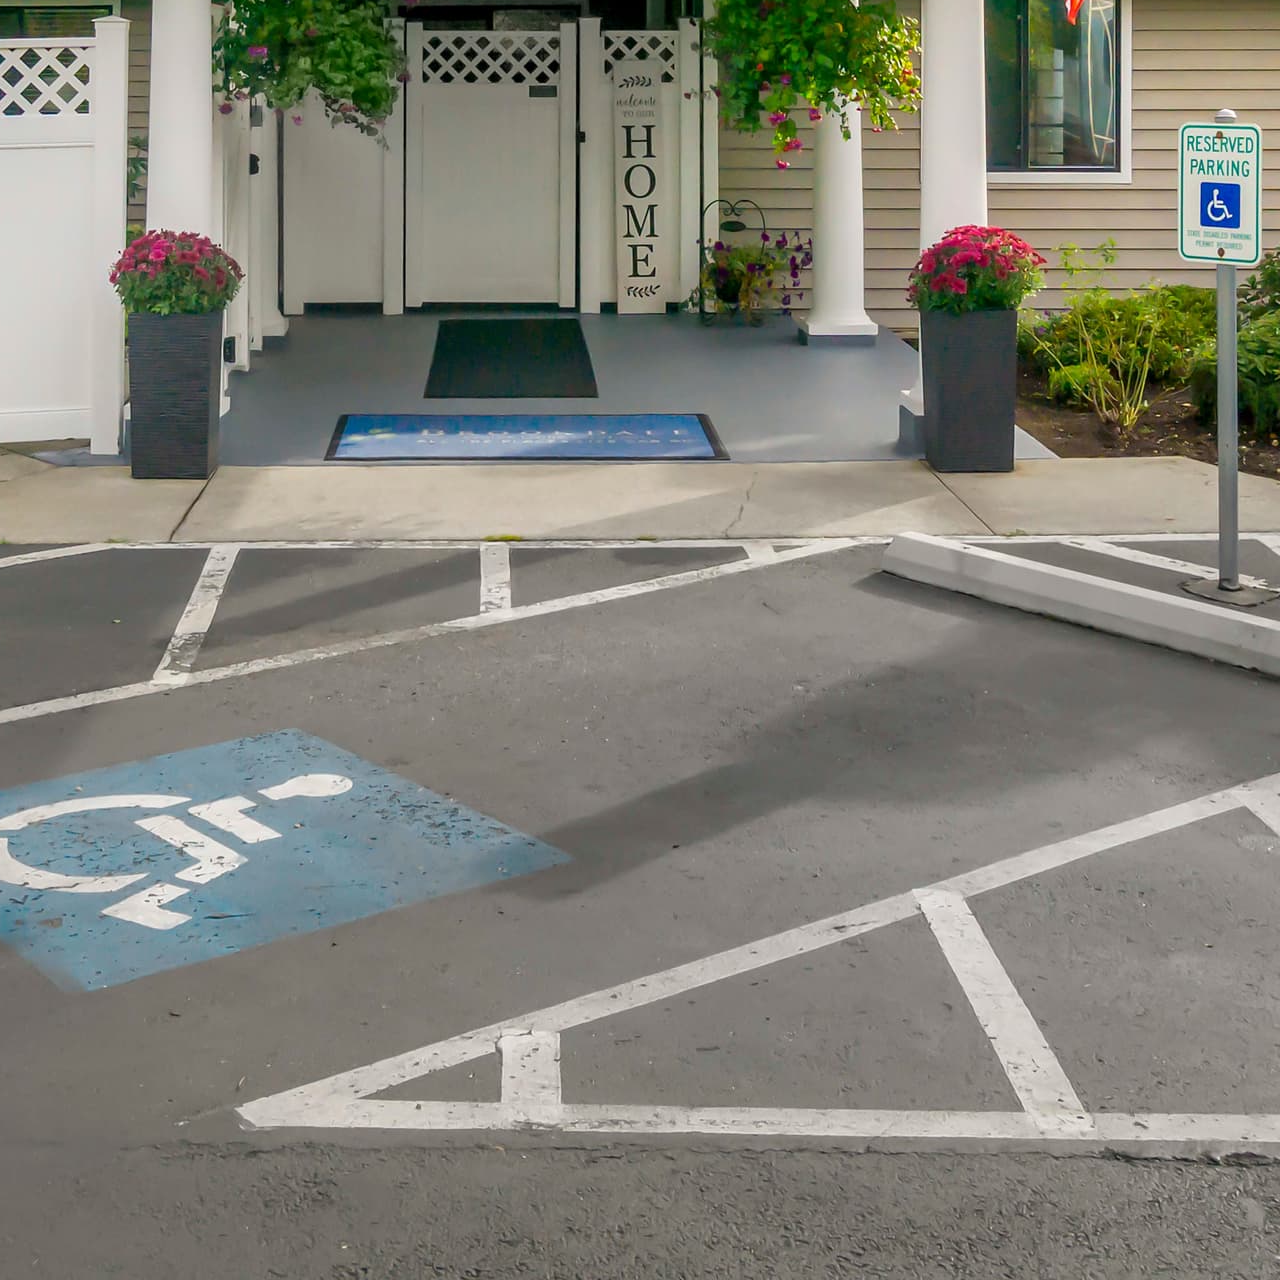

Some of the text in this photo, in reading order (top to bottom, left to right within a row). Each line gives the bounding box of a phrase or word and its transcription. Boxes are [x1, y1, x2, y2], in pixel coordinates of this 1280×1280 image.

[1186, 135, 1254, 153] RESERVED
[1190, 158, 1250, 177] PARKING
[622, 125, 659, 278] HOME
